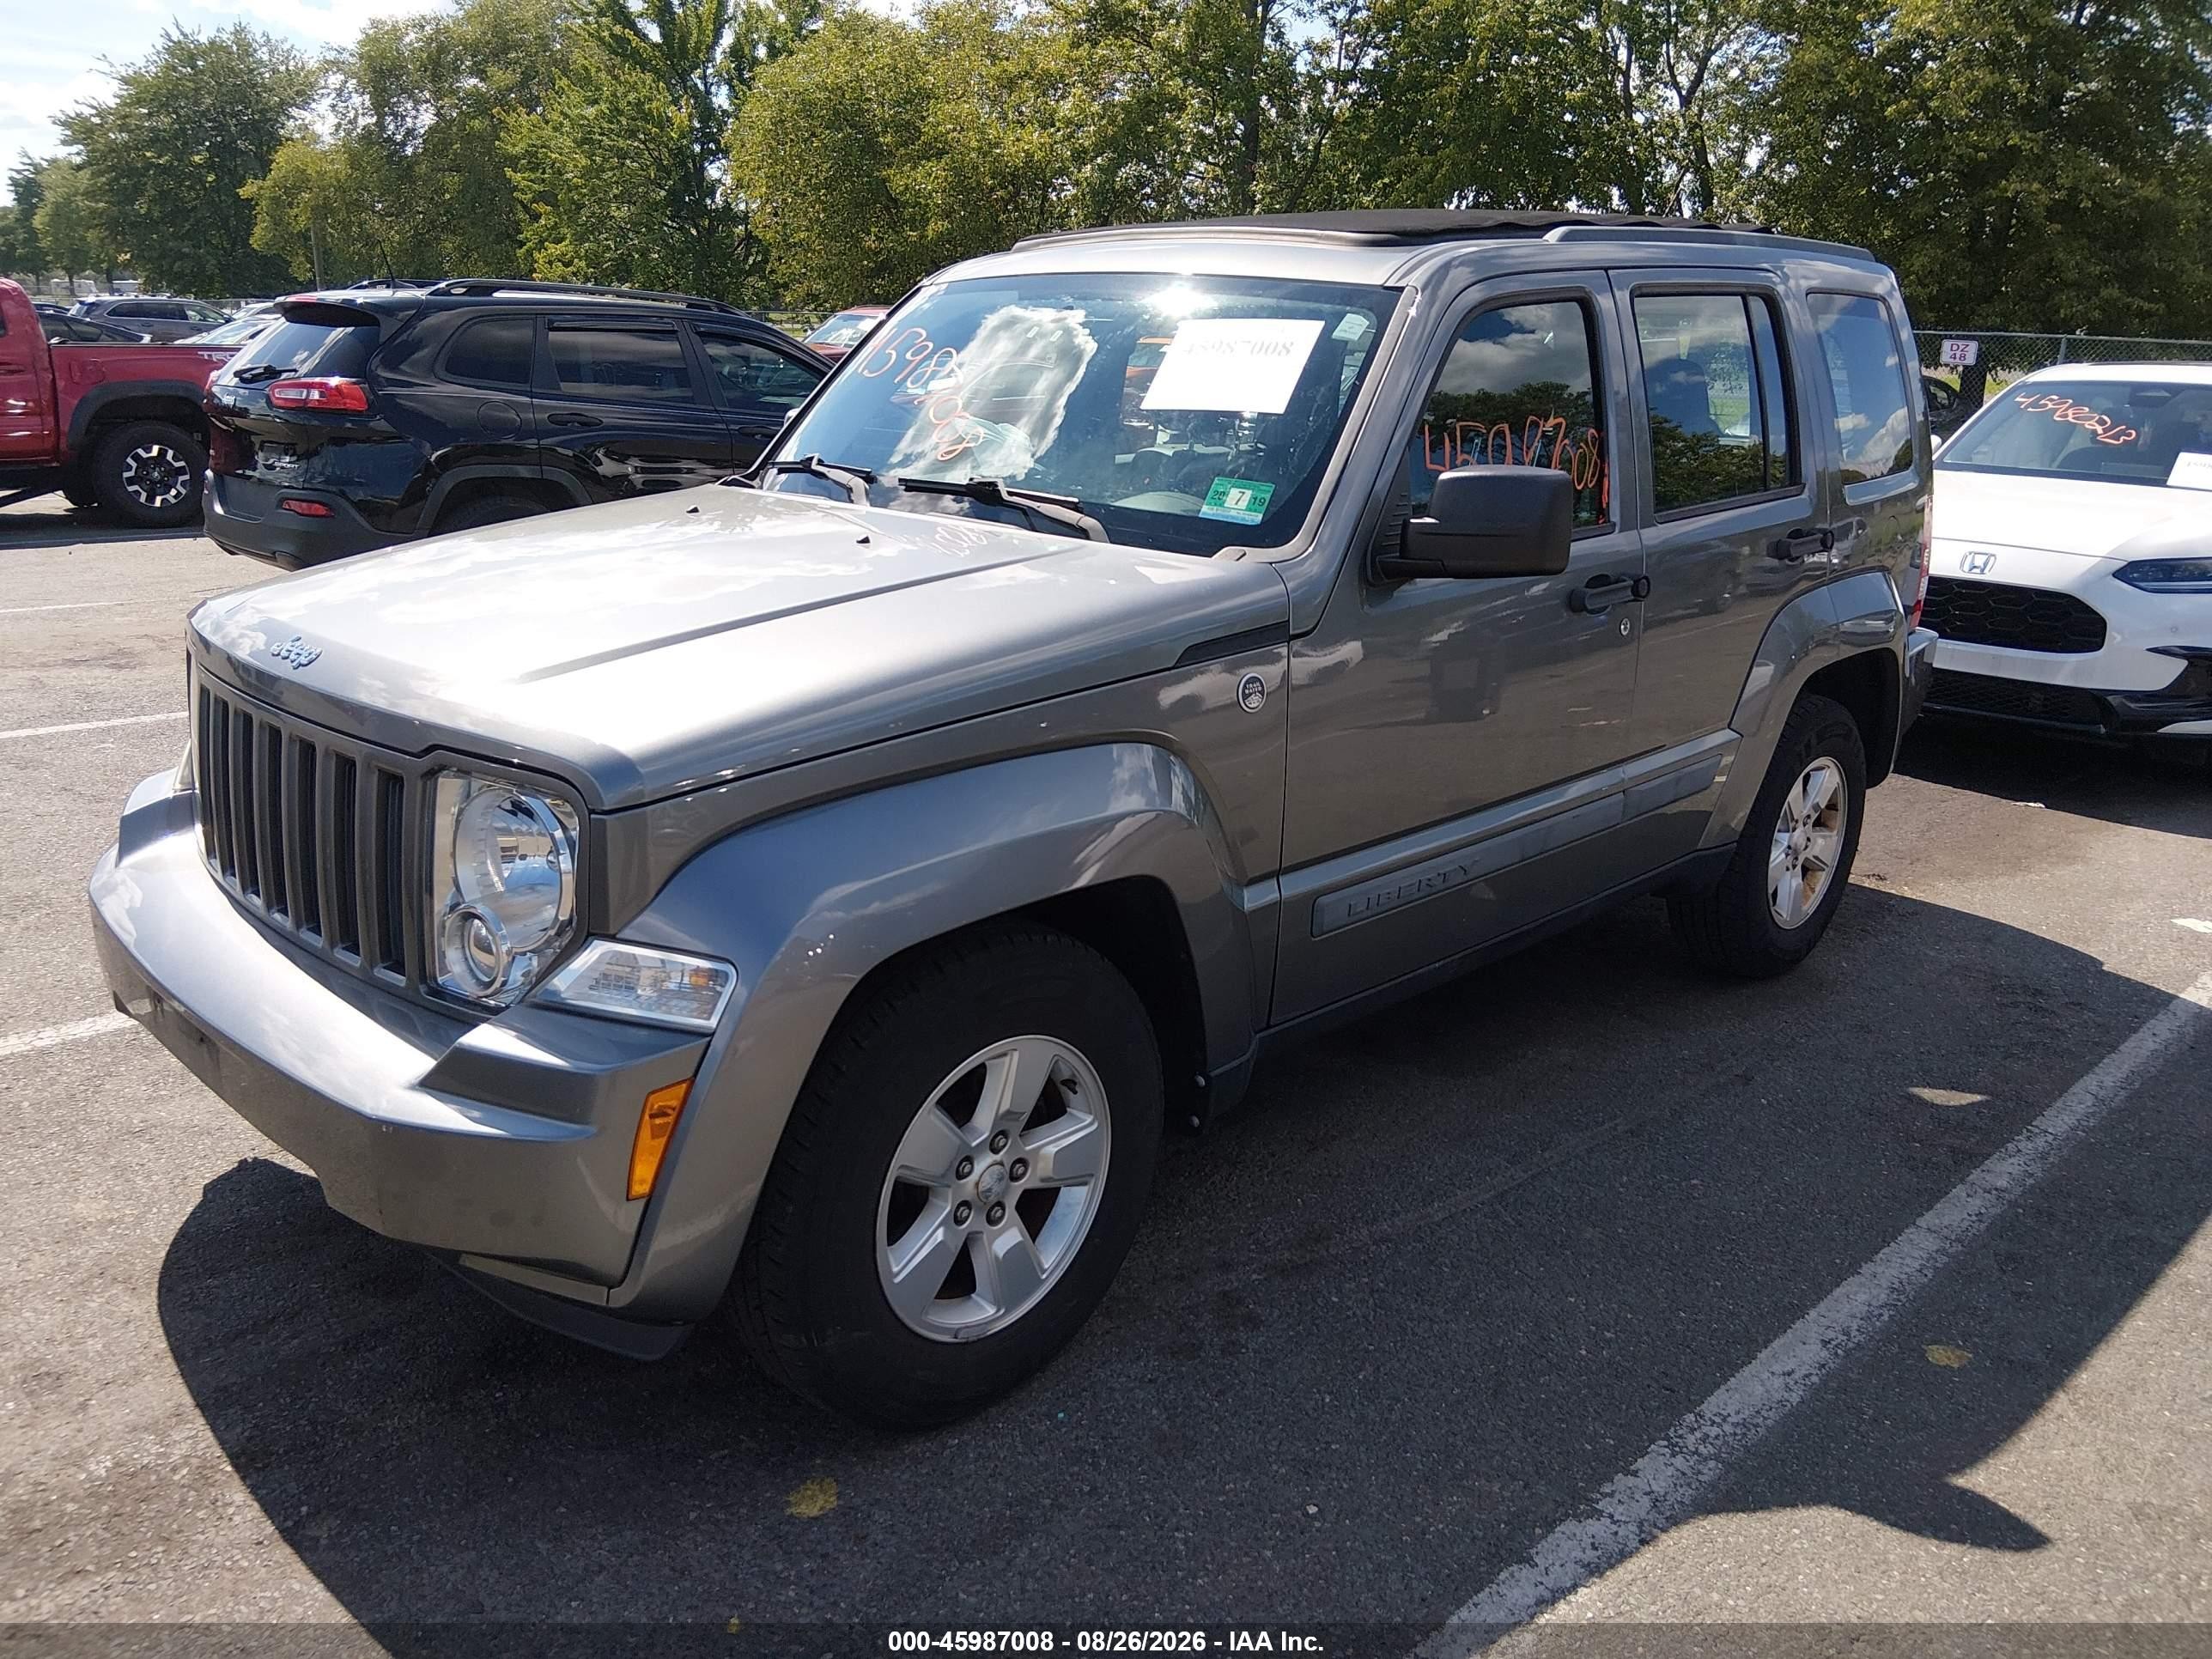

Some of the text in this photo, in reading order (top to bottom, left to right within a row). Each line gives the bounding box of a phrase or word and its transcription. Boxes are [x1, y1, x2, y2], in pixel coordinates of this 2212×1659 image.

[1950, 343, 1970, 352] DZ
[1949, 353, 1966, 362] 48
[1235, 490, 1246, 506] 7
[1252, 495, 1267, 507] 19
[270, 635, 323, 670] Jeep
[1346, 857, 1480, 917] LIBERTY
